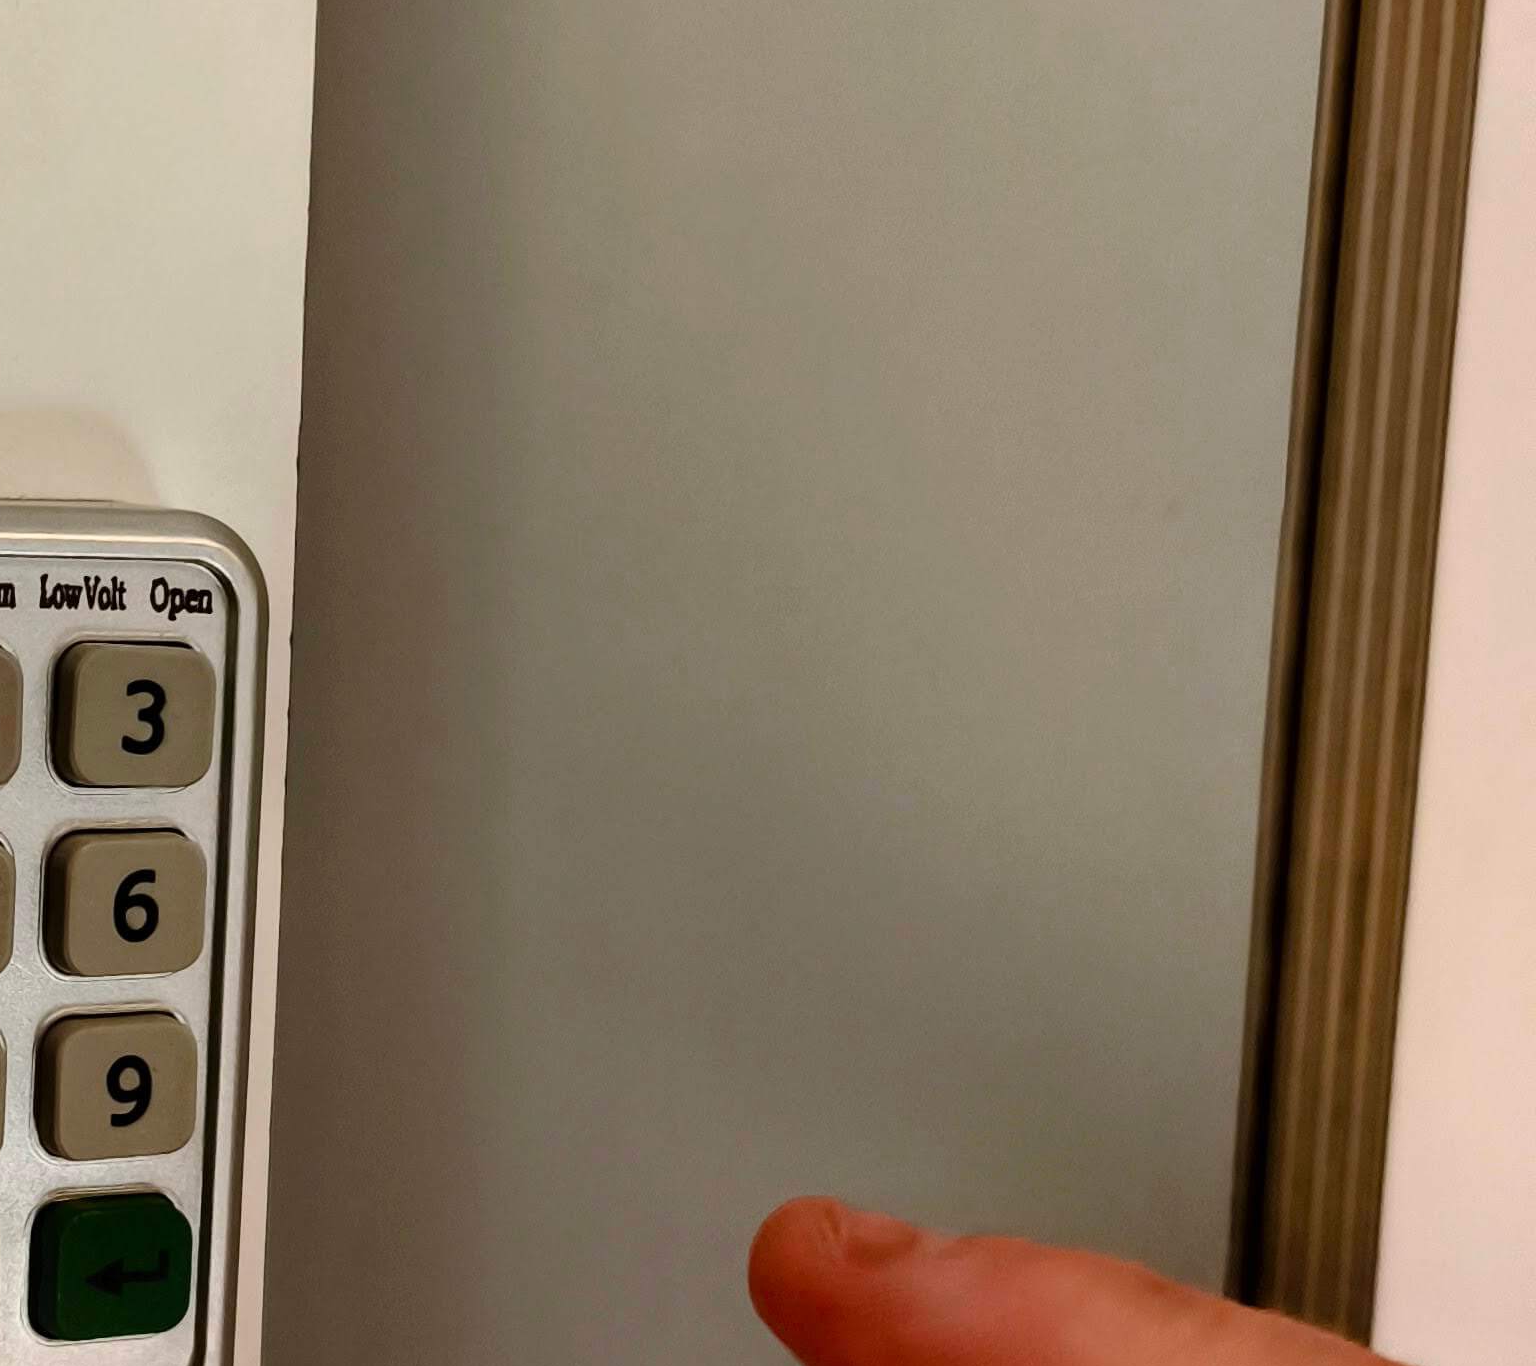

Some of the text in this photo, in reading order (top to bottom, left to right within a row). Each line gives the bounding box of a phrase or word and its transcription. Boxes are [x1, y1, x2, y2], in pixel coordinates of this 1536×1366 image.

[149, 577, 213, 621] Open
[120, 680, 166, 755] 3
[113, 869, 159, 943] 6
[105, 1055, 152, 1127] 9
